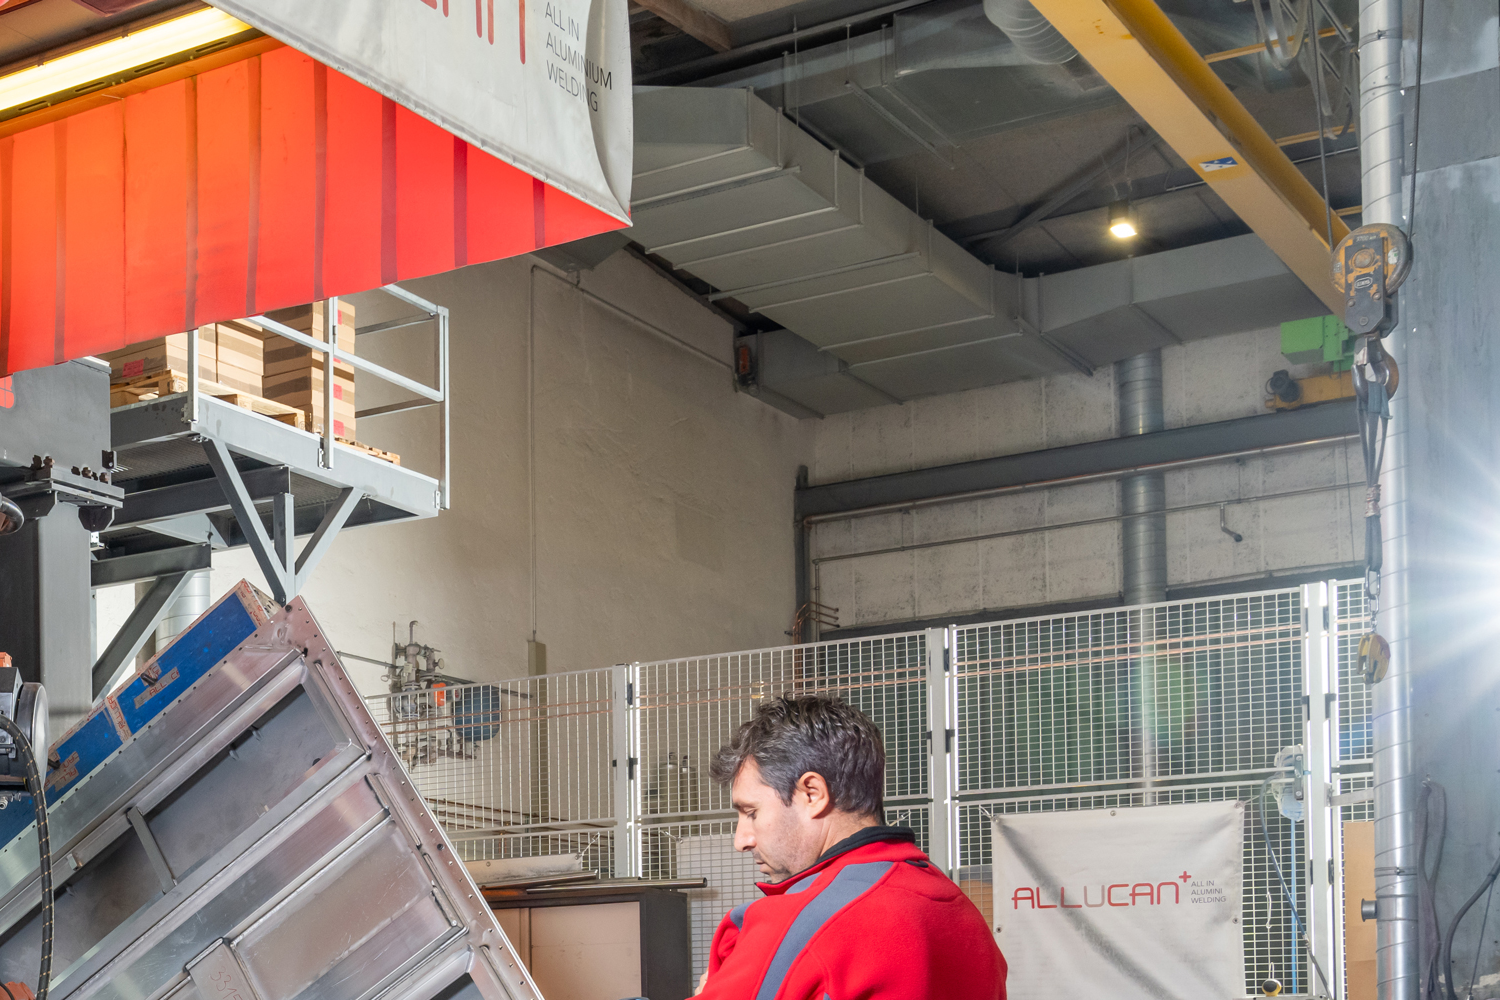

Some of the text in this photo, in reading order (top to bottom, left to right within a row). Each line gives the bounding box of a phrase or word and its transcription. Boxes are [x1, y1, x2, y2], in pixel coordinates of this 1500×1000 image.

[545, 2, 580, 41] ALL IN
[546, 32, 612, 90] ALUMINIUM
[546, 60, 598, 112] WELDING
